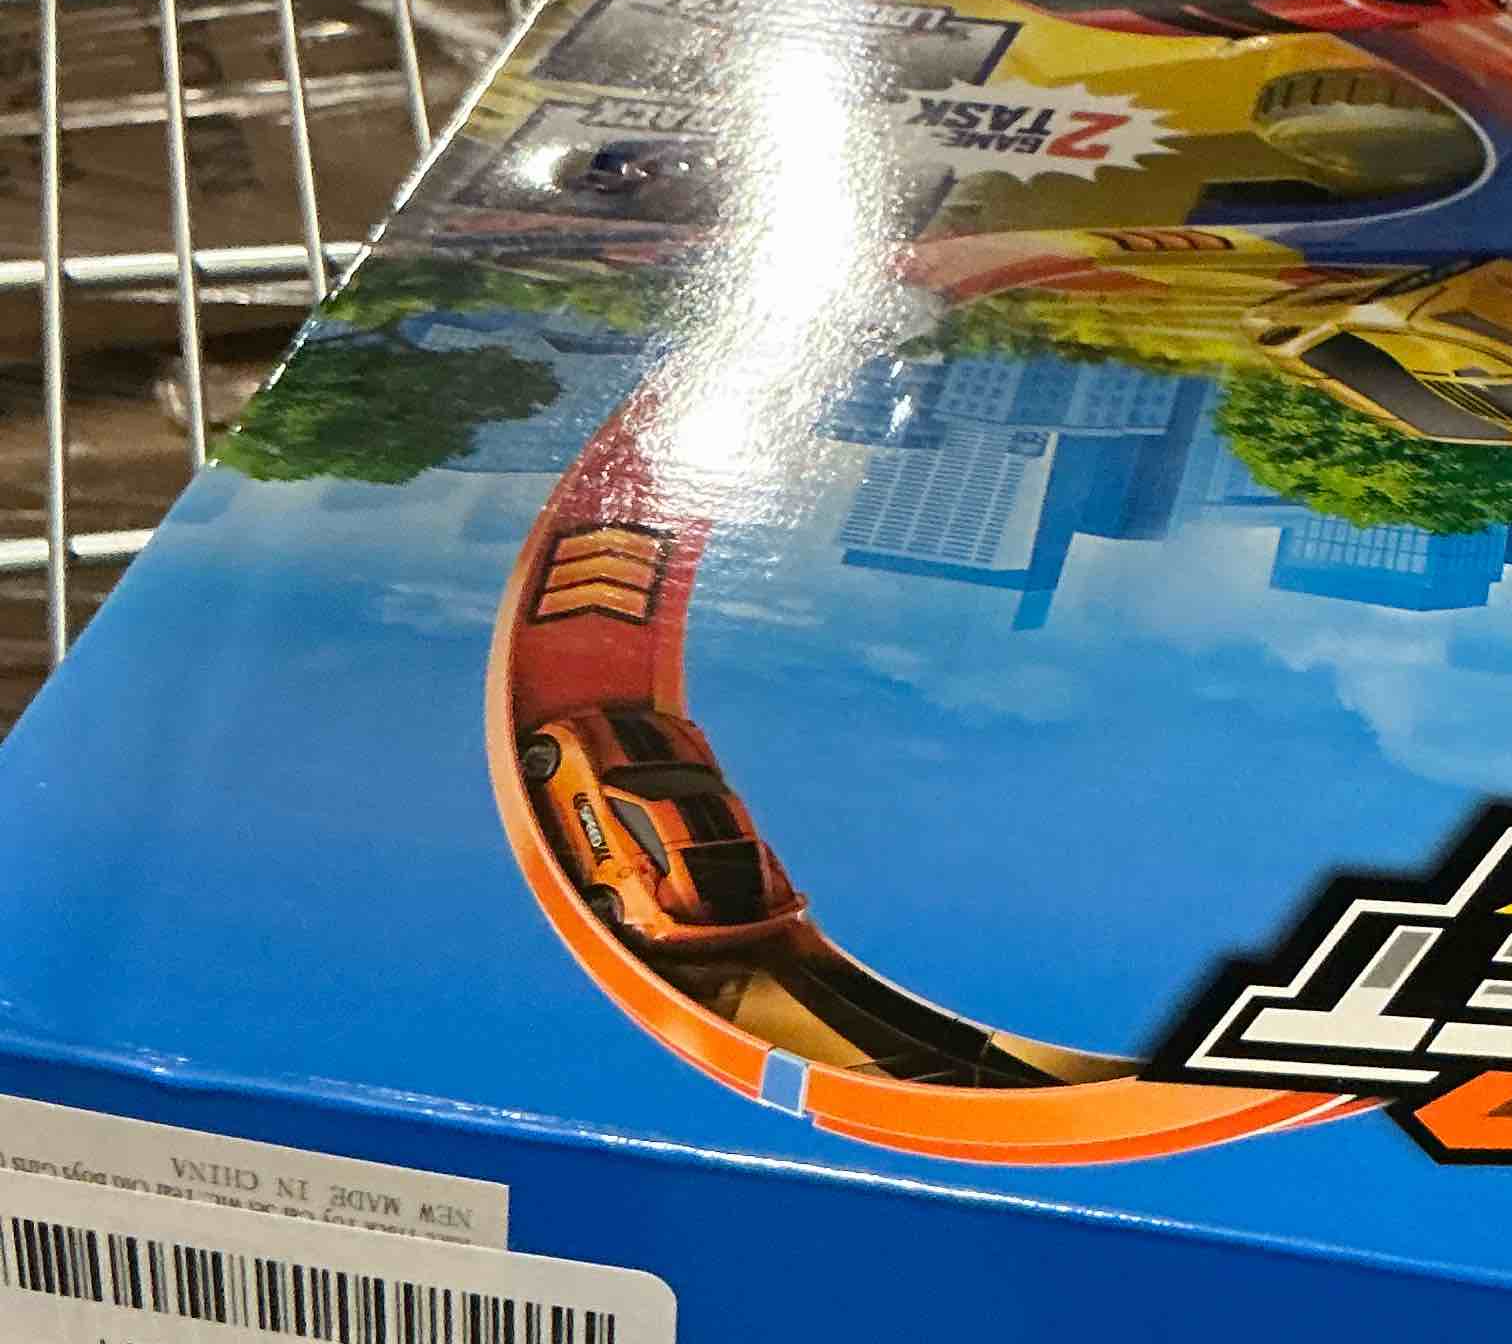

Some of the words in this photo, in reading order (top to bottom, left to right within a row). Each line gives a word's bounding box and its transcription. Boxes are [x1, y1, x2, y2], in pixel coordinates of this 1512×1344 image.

[906, 98, 1055, 136] TASK
[1045, 110, 1131, 161] 2
[169, 1157, 260, 1191] CHINA
[276, 1177, 310, 1202] IN
[329, 1185, 401, 1217] MADE
[418, 1202, 472, 1229] NEW
